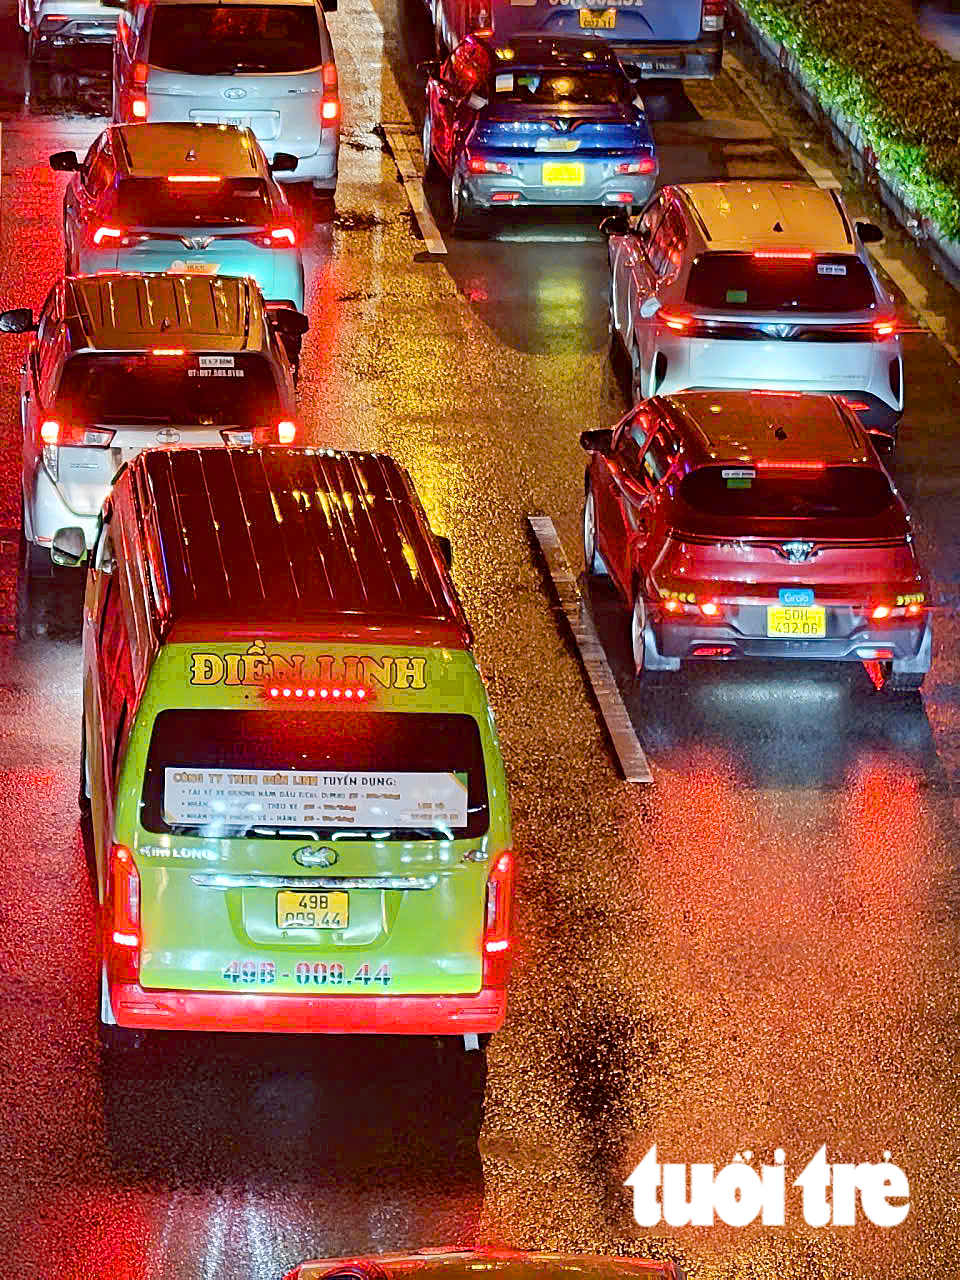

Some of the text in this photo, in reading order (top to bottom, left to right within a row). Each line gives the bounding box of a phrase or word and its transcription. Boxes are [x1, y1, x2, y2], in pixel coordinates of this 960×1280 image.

[783, 592, 809, 604] Grab
[315, 655, 428, 689] LINH
[298, 895, 329, 910] 49B
[284, 911, 341, 927] 009.44
